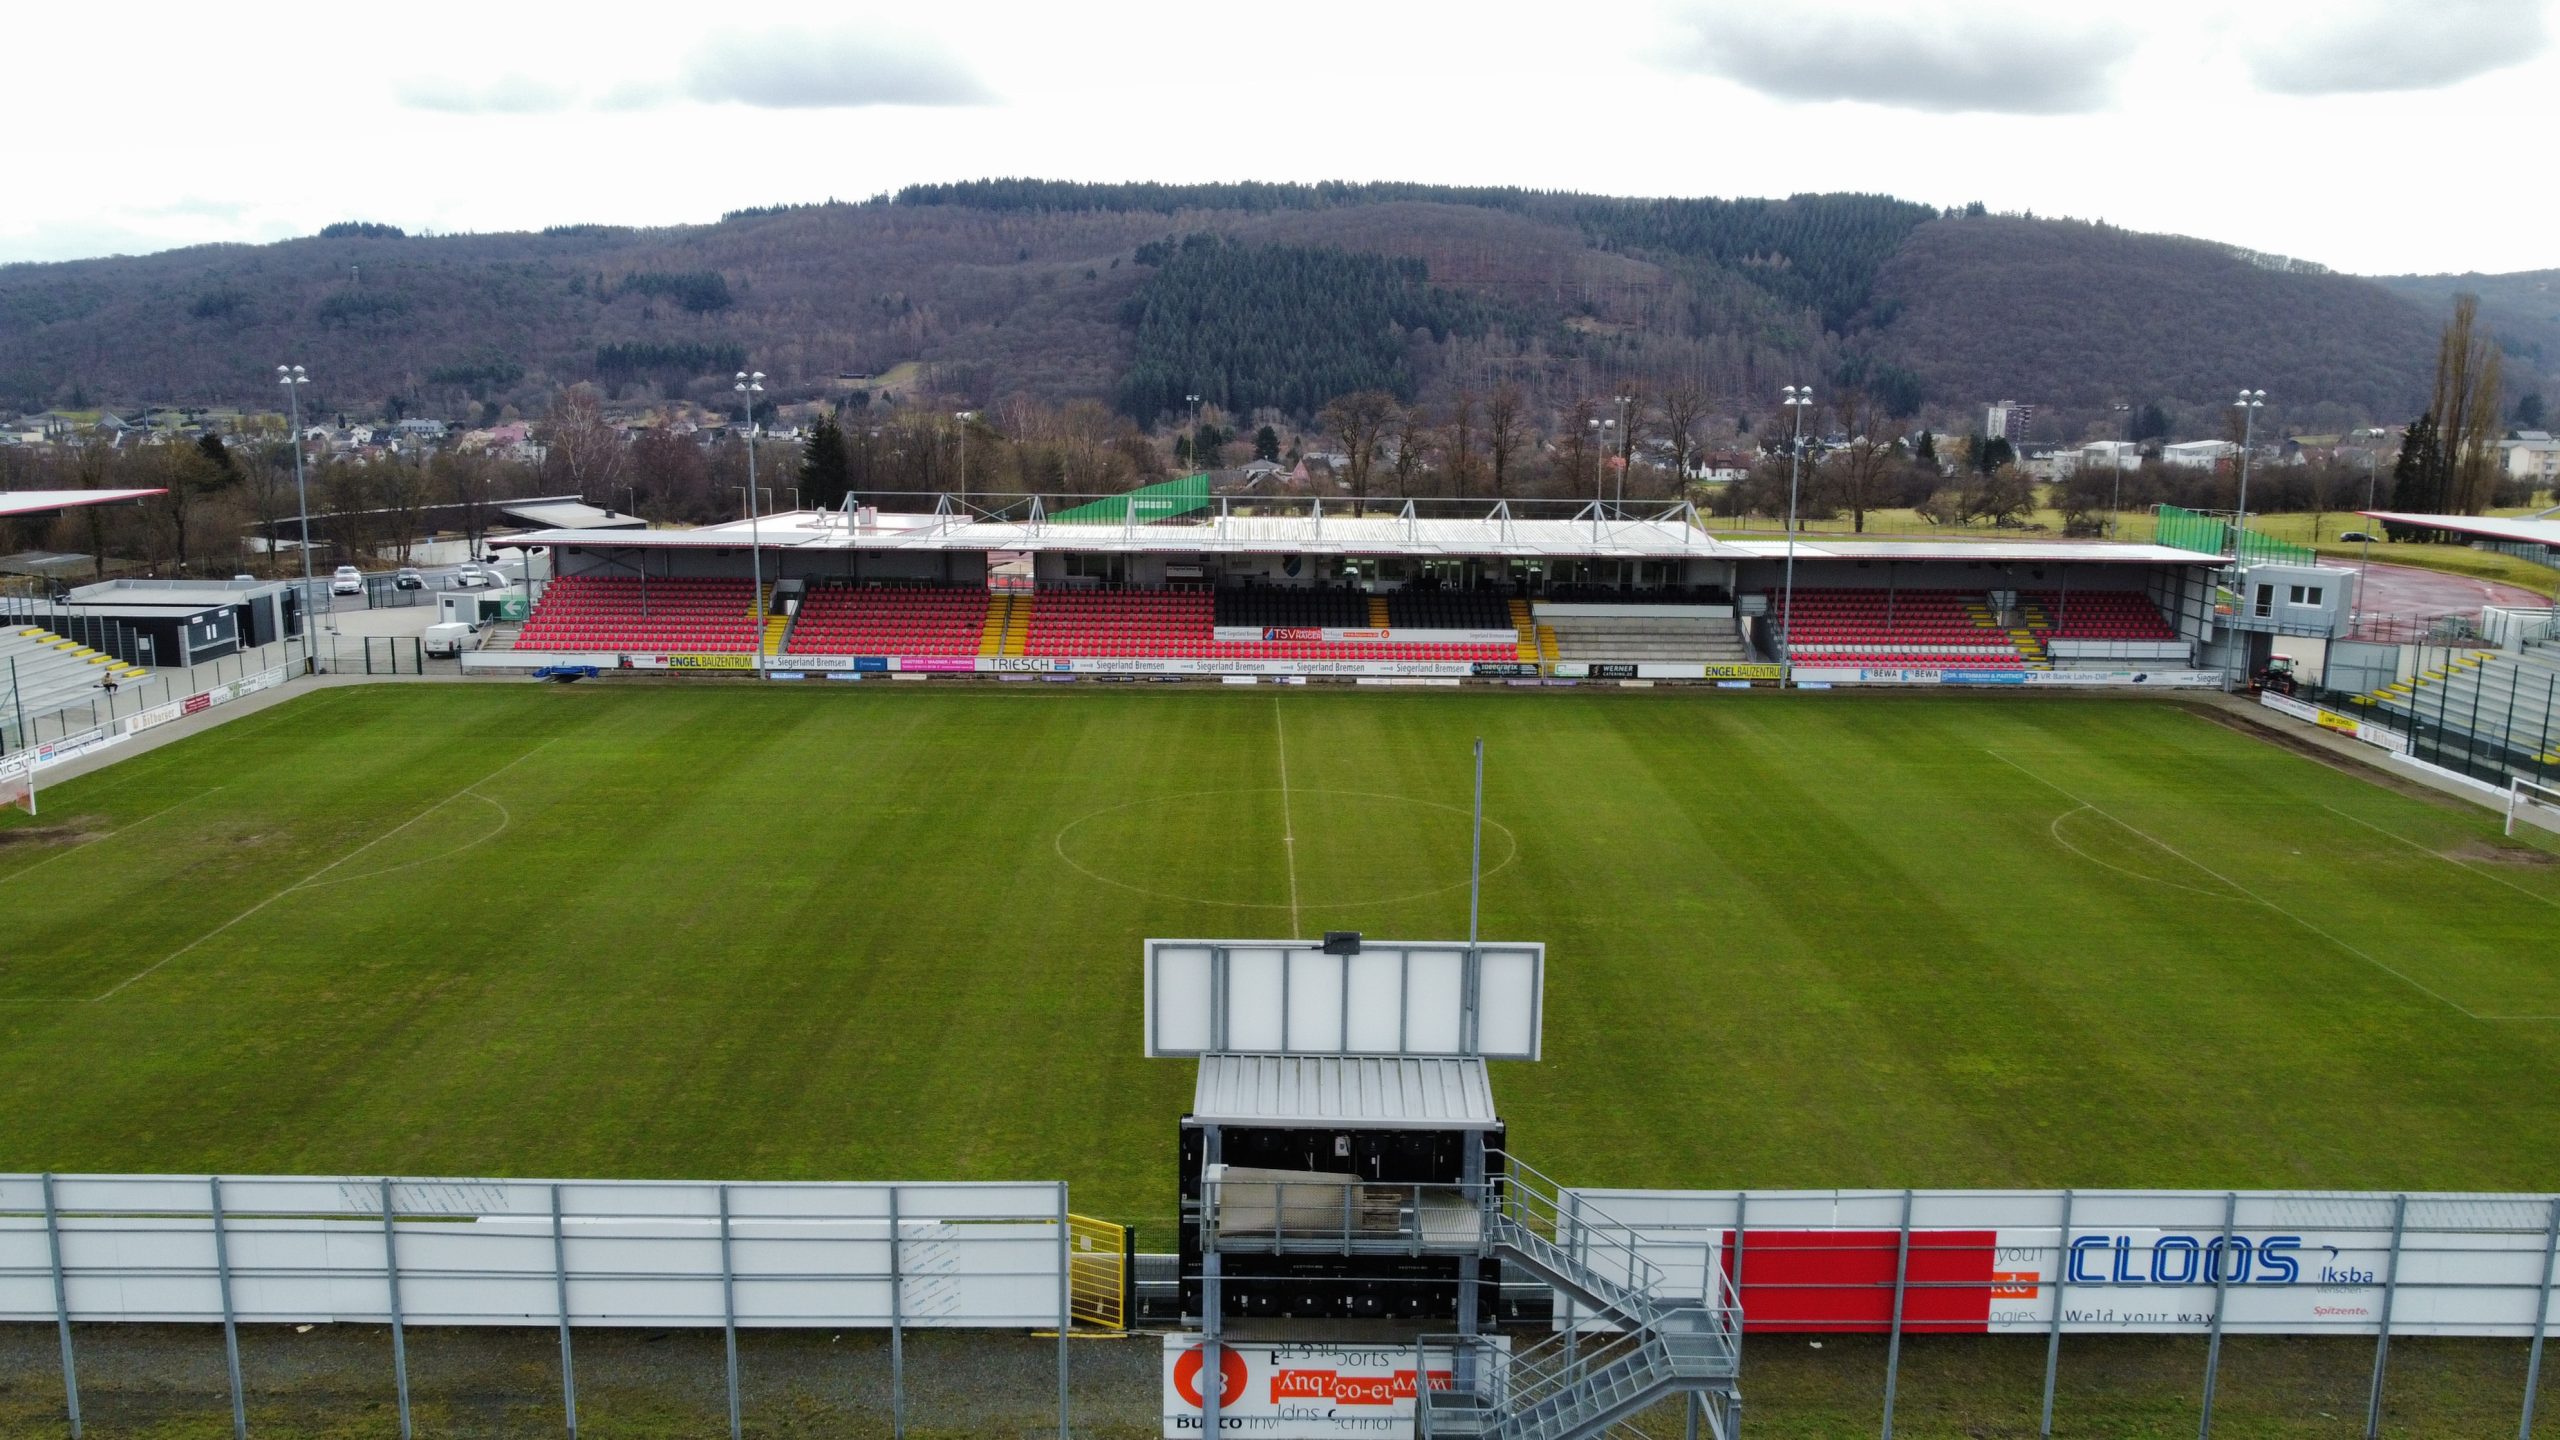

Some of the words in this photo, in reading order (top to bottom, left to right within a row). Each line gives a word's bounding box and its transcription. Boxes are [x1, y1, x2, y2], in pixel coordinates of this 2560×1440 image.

[1274, 629, 1296, 639] TSV
[670, 656, 701, 667] ENGEL
[702, 657, 752, 667] BAUZENTRUM
[777, 657, 815, 669] Siegerland
[816, 658, 847, 667] Bremsen
[990, 659, 1049, 671] TRIESCH
[1096, 660, 1133, 672] Siegerland
[1135, 661, 1165, 671] Bremsen
[1196, 661, 1233, 672] Siegerland
[1235, 662, 1265, 671] Bremsen
[1296, 662, 1333, 674] Siegerland
[1335, 663, 1365, 672] Bremsen
[1396, 663, 1433, 675] Siegerland
[1434, 664, 1465, 673] Bremsen
[1705, 666, 1736, 677] ENGEL
[1737, 666, 1787, 677] BAUZENTRU
[1874, 669, 1897, 678] BEWA
[1915, 670, 1938, 678] BEWA
[2068, 1235, 2301, 1288] CLOOS
[1991, 1274, 2029, 1294] .de
[2065, 1309, 2113, 1324] Weld
[2123, 1310, 2168, 1327] your
[2313, 1306, 2369, 1322] Spitzente
[1176, 1413, 1243, 1429] Buco
